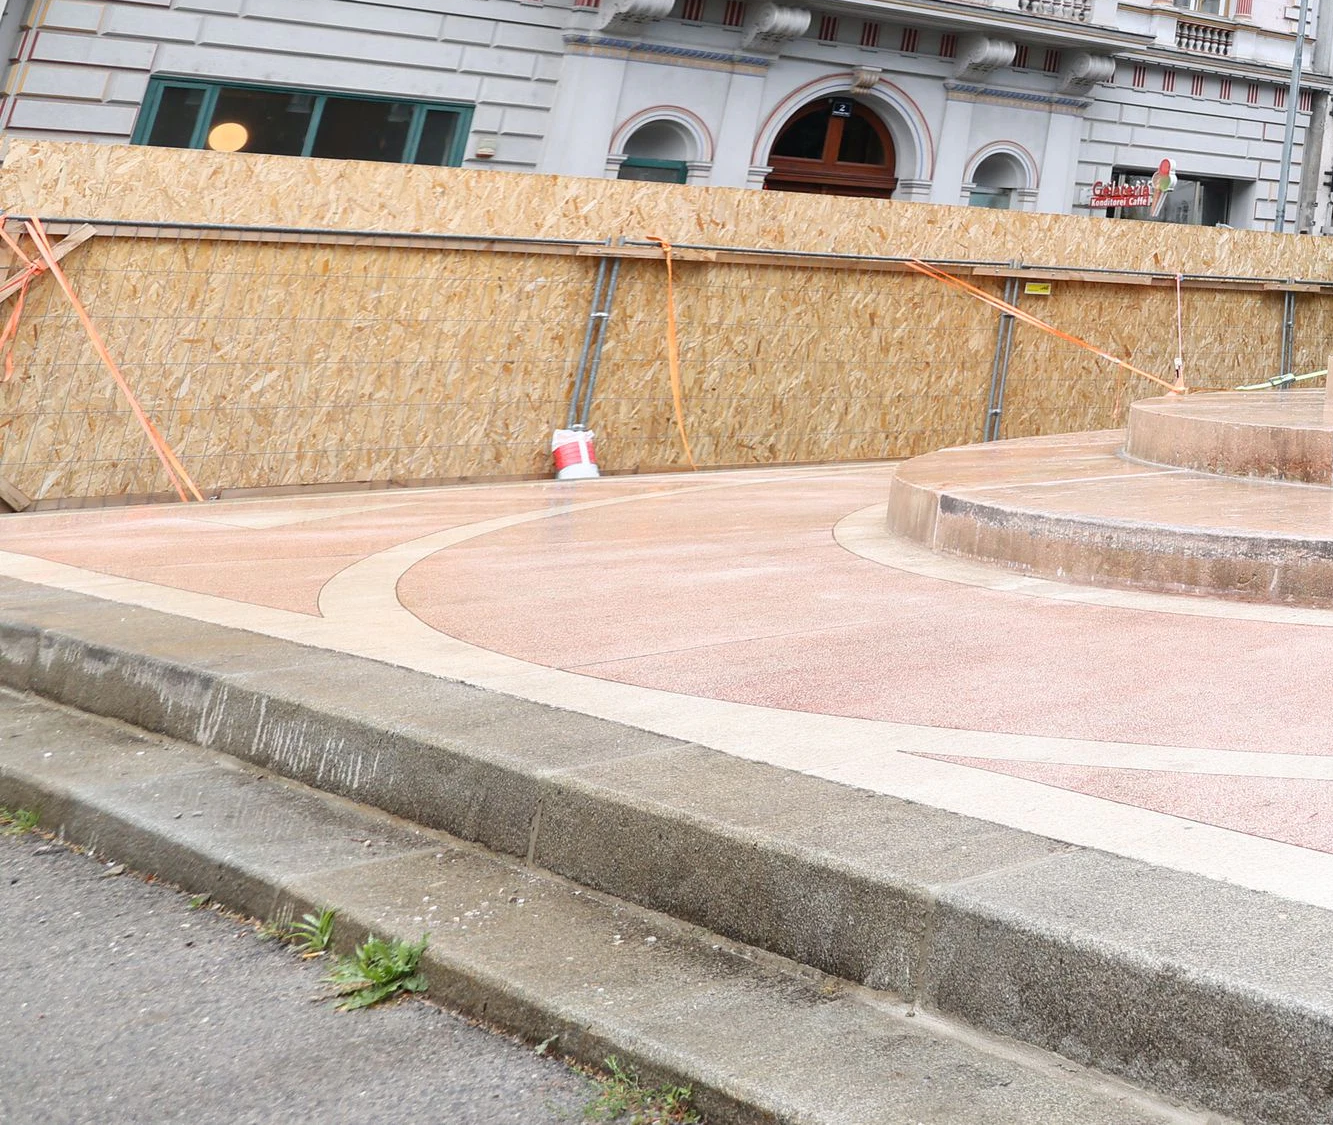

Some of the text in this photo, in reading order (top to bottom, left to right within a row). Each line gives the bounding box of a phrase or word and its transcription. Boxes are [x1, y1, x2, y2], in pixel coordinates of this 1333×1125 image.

[839, 104, 846, 112] 2
[1093, 180, 1151, 197] Gelateria
[1091, 198, 1126, 207] Konditorei
